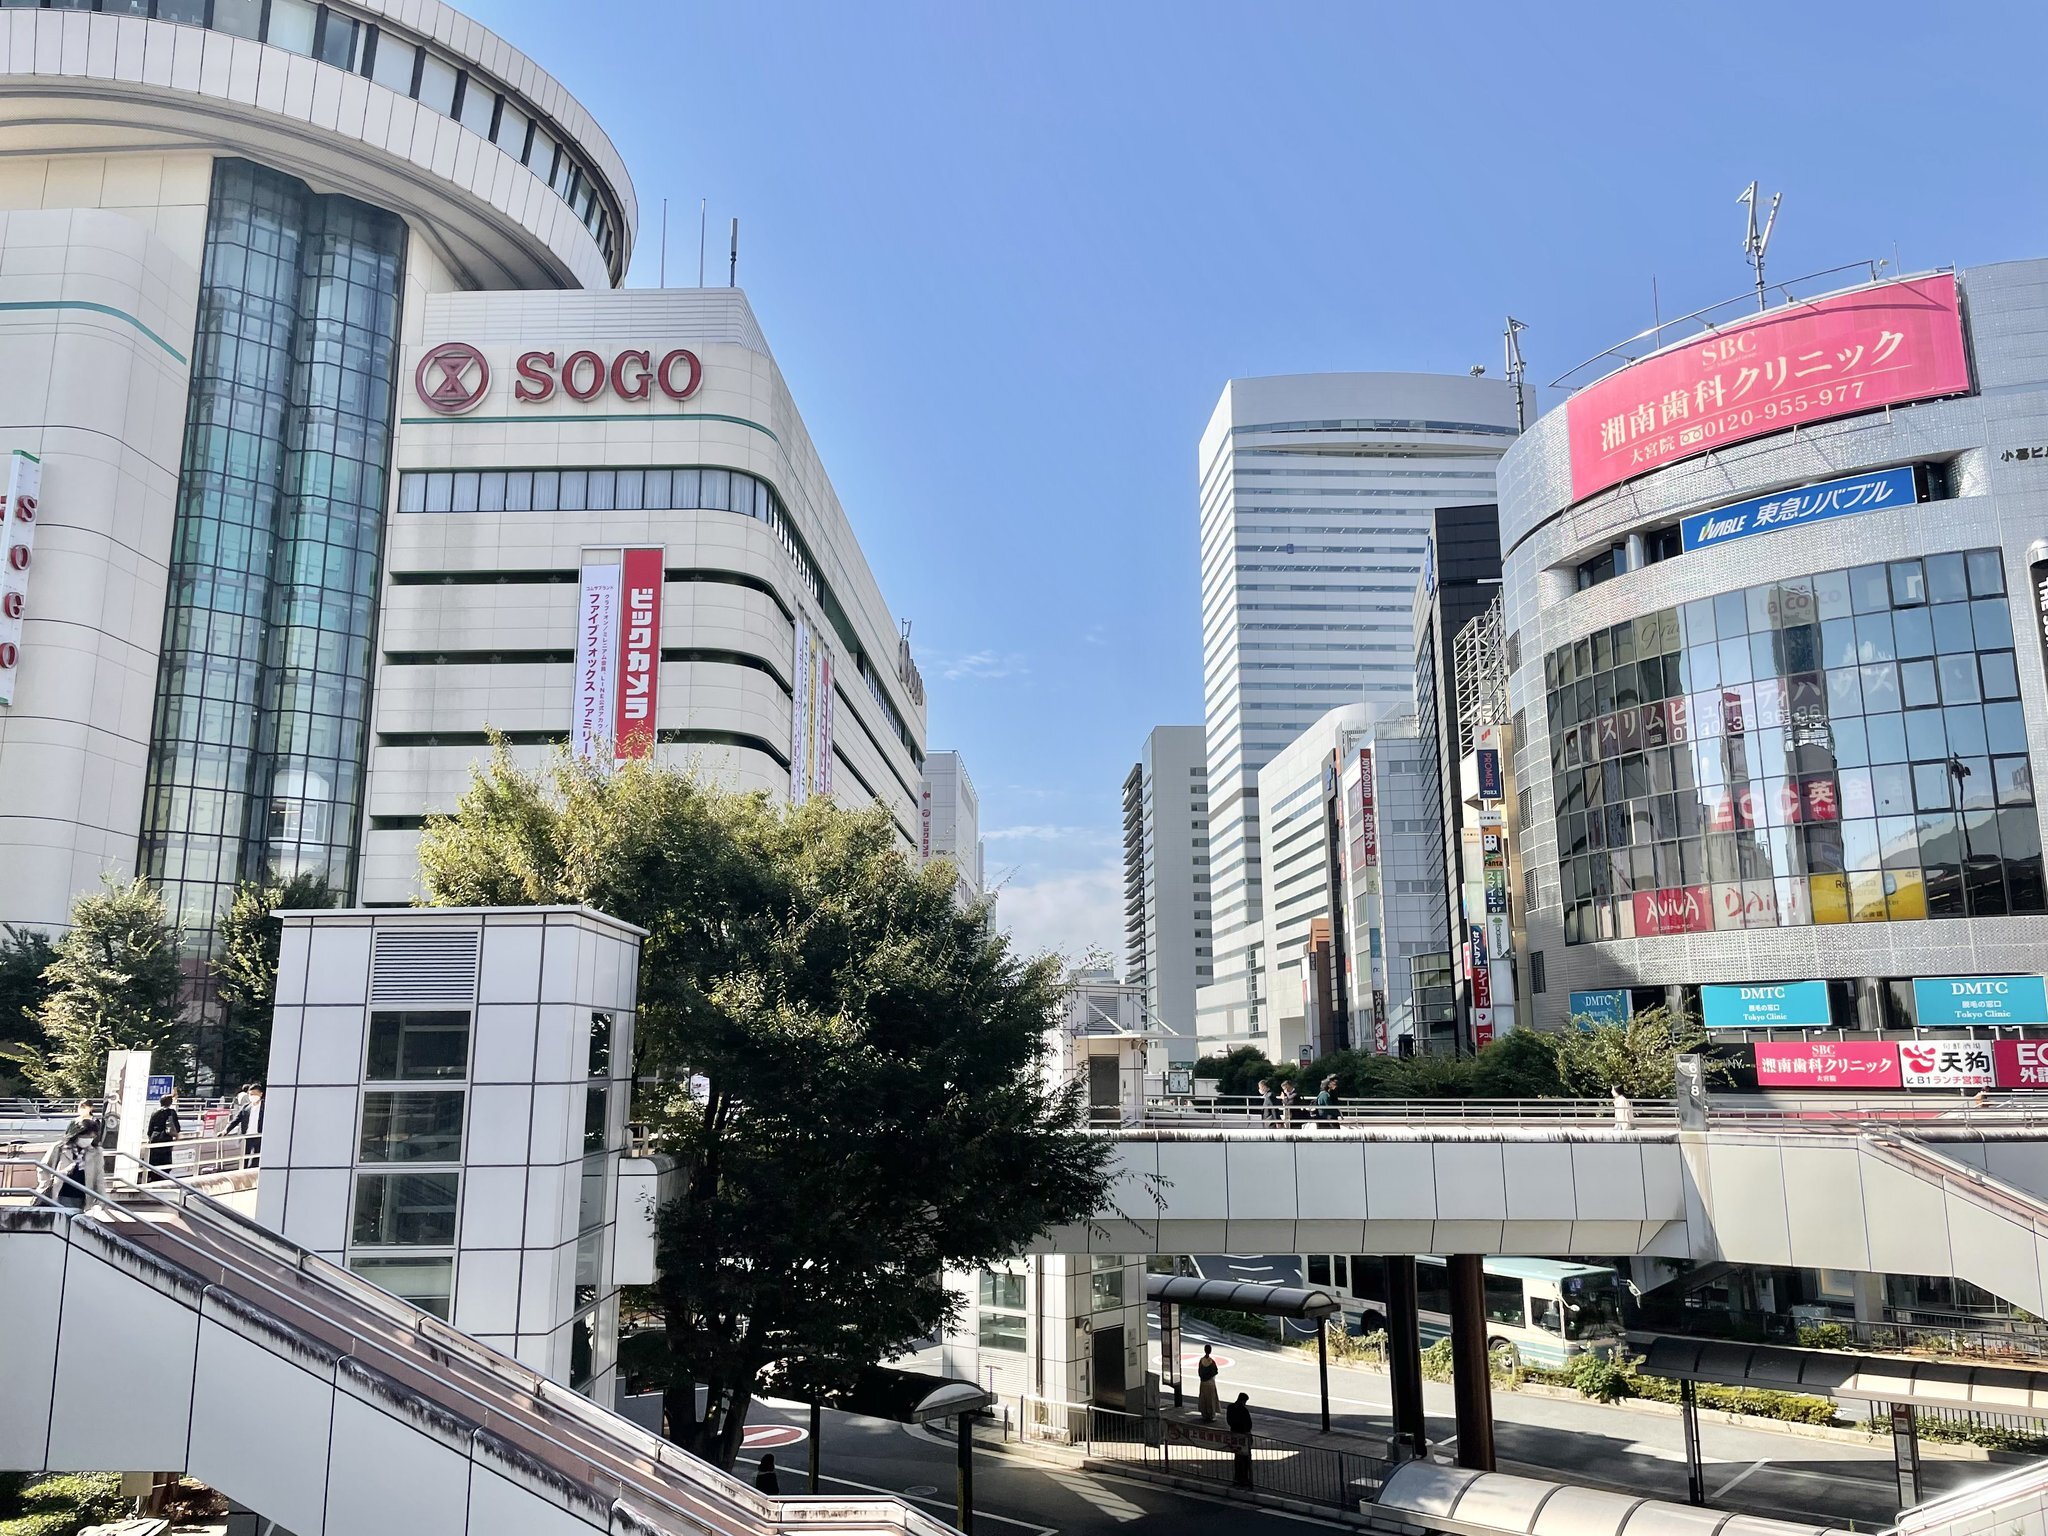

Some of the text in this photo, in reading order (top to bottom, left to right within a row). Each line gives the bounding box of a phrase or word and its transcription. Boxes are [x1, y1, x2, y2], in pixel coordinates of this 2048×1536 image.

[1702, 332, 1756, 366] SBC
[515, 349, 703, 402] SOGO
[1600, 331, 1904, 452] 湘南歯科クリニック
[1630, 381, 1865, 466] 大宮院 0120-955-977
[1752, 479, 1893, 528] 東急リバブル
[625, 588, 653, 719] ビックカメラ
[1362, 758, 1372, 798] JOYSOUND
[1484, 752, 1494, 787] PROMISE
[1364, 813, 1375, 848] カラオケ
[1472, 930, 1481, 965] セントラル
[1477, 968, 1490, 1006] アイフル
[1585, 995, 1611, 1006] DMTC
[1741, 987, 1785, 999] DMTC
[1951, 982, 2008, 995] DMTC
[1743, 1012, 1787, 1022] Tokyo Clinic
[1955, 1010, 2011, 1019] Tokyo Clinic
[1762, 1057, 1892, 1073] 湘南歯科クリニック
[1811, 1044, 1836, 1055] SBC
[1939, 1051, 1991, 1073] 天狗
[1689, 1063, 1699, 1096] 6 7 8
